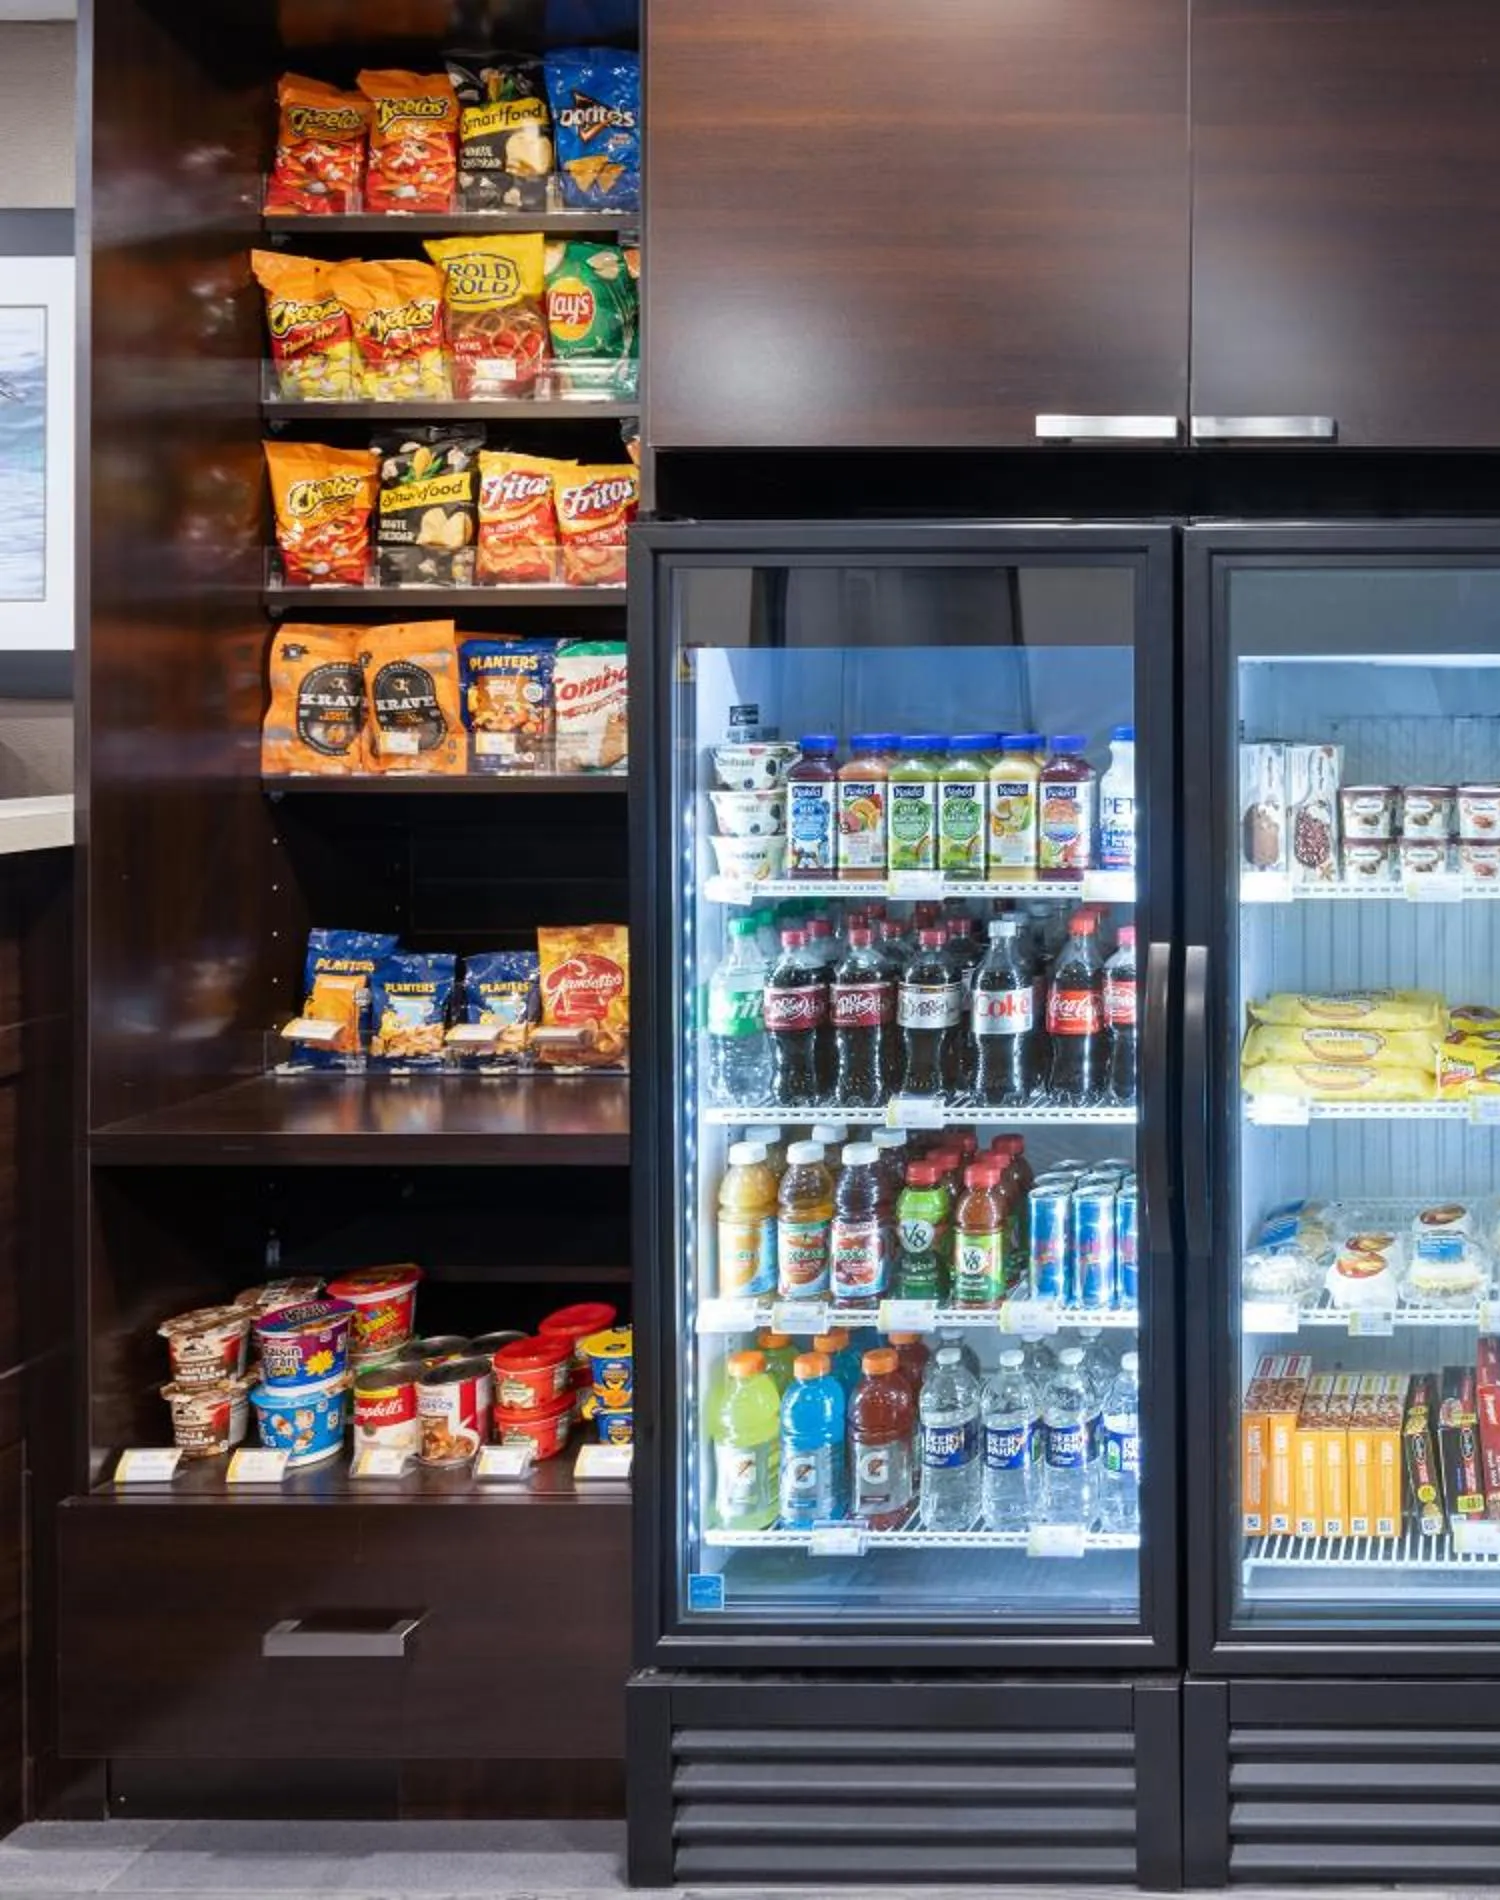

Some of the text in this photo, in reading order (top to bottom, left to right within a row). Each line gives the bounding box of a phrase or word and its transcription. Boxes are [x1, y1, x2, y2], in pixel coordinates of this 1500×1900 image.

[462, 104, 543, 135] Smartfood
[560, 105, 635, 127] Doritos
[448, 263, 511, 281] ROLD
[549, 290, 590, 325] Lay's
[482, 472, 552, 508] Fritos
[561, 480, 635, 519] Fritos
[469, 655, 538, 670] PLANTERS
[375, 695, 436, 711] KRAVE
[315, 958, 375, 972] PLANTERS
[384, 982, 436, 993] PLANTERS
[480, 982, 530, 994] PLANTERS
[903, 1223, 927, 1249] V8
[963, 1250, 981, 1271] V8
